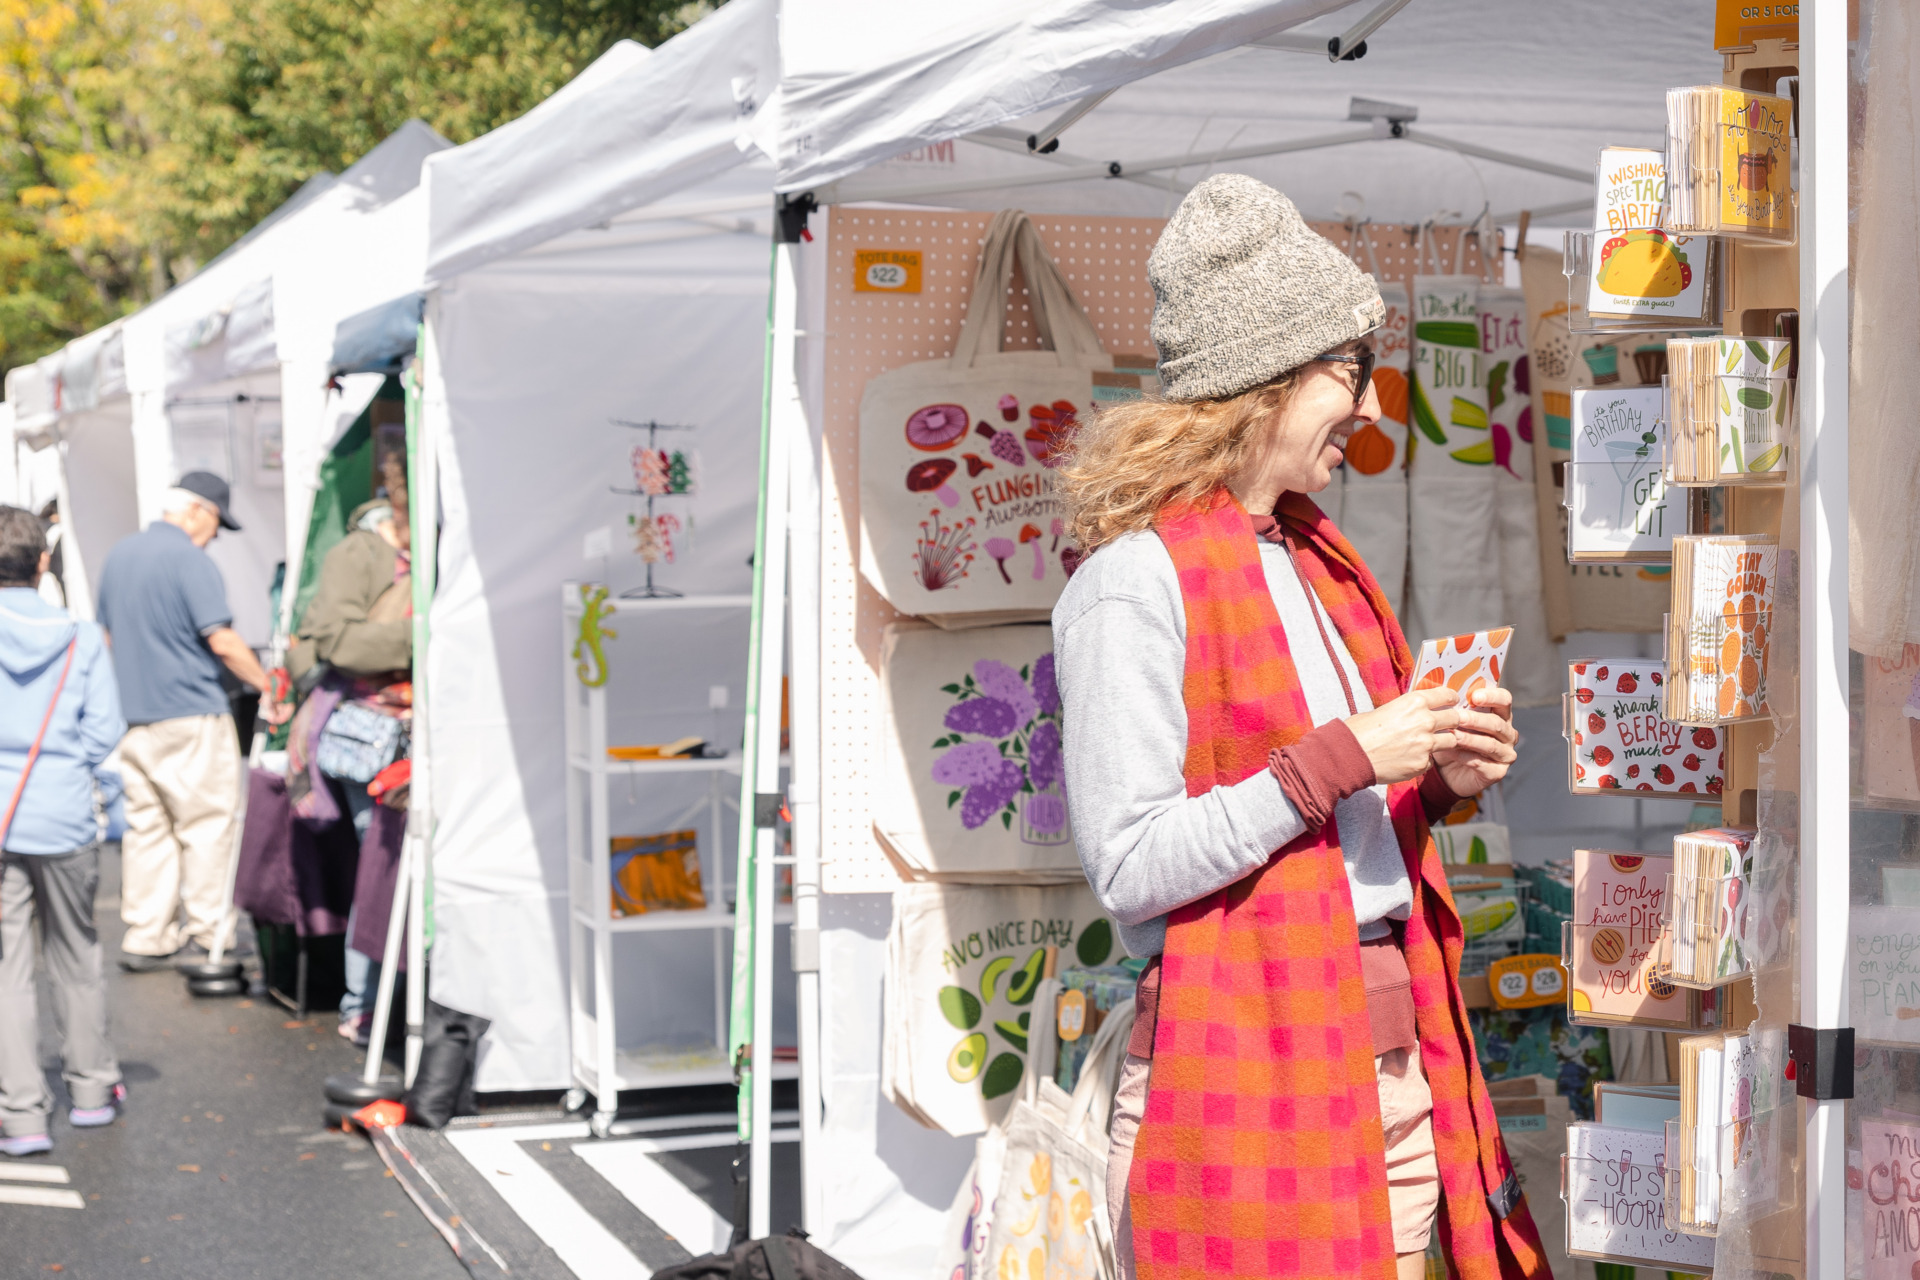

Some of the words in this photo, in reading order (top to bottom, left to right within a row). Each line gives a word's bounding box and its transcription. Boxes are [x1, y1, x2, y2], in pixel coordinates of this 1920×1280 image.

[1741, 7, 1760, 19] OR
[1763, 6, 1771, 18] 5
[1774, 4, 1799, 17] FOR
[858, 252, 888, 264] TOTE
[892, 252, 918, 266] BAG
[871, 266, 898, 283] $22
[1631, 299, 1650, 307] EXTRA
[1433, 348, 1465, 388] BIG
[1608, 398, 1628, 413] your
[1583, 407, 1642, 447] BIRTHDAY
[1633, 469, 1670, 506] GET
[1635, 504, 1668, 537] LIT
[1736, 552, 1763, 574] STAY
[1726, 572, 1767, 599] GOLDEN
[1613, 694, 1659, 720] thank
[1616, 714, 1683, 756] BERRY
[1623, 743, 1662, 760] much
[1602, 882, 1609, 907] I
[1585, 907, 1628, 928] have
[1031, 919, 1074, 948] DAY
[1629, 948, 1652, 966] for
[1858, 960, 1881, 974] on
[1599, 968, 1642, 999] YOU
